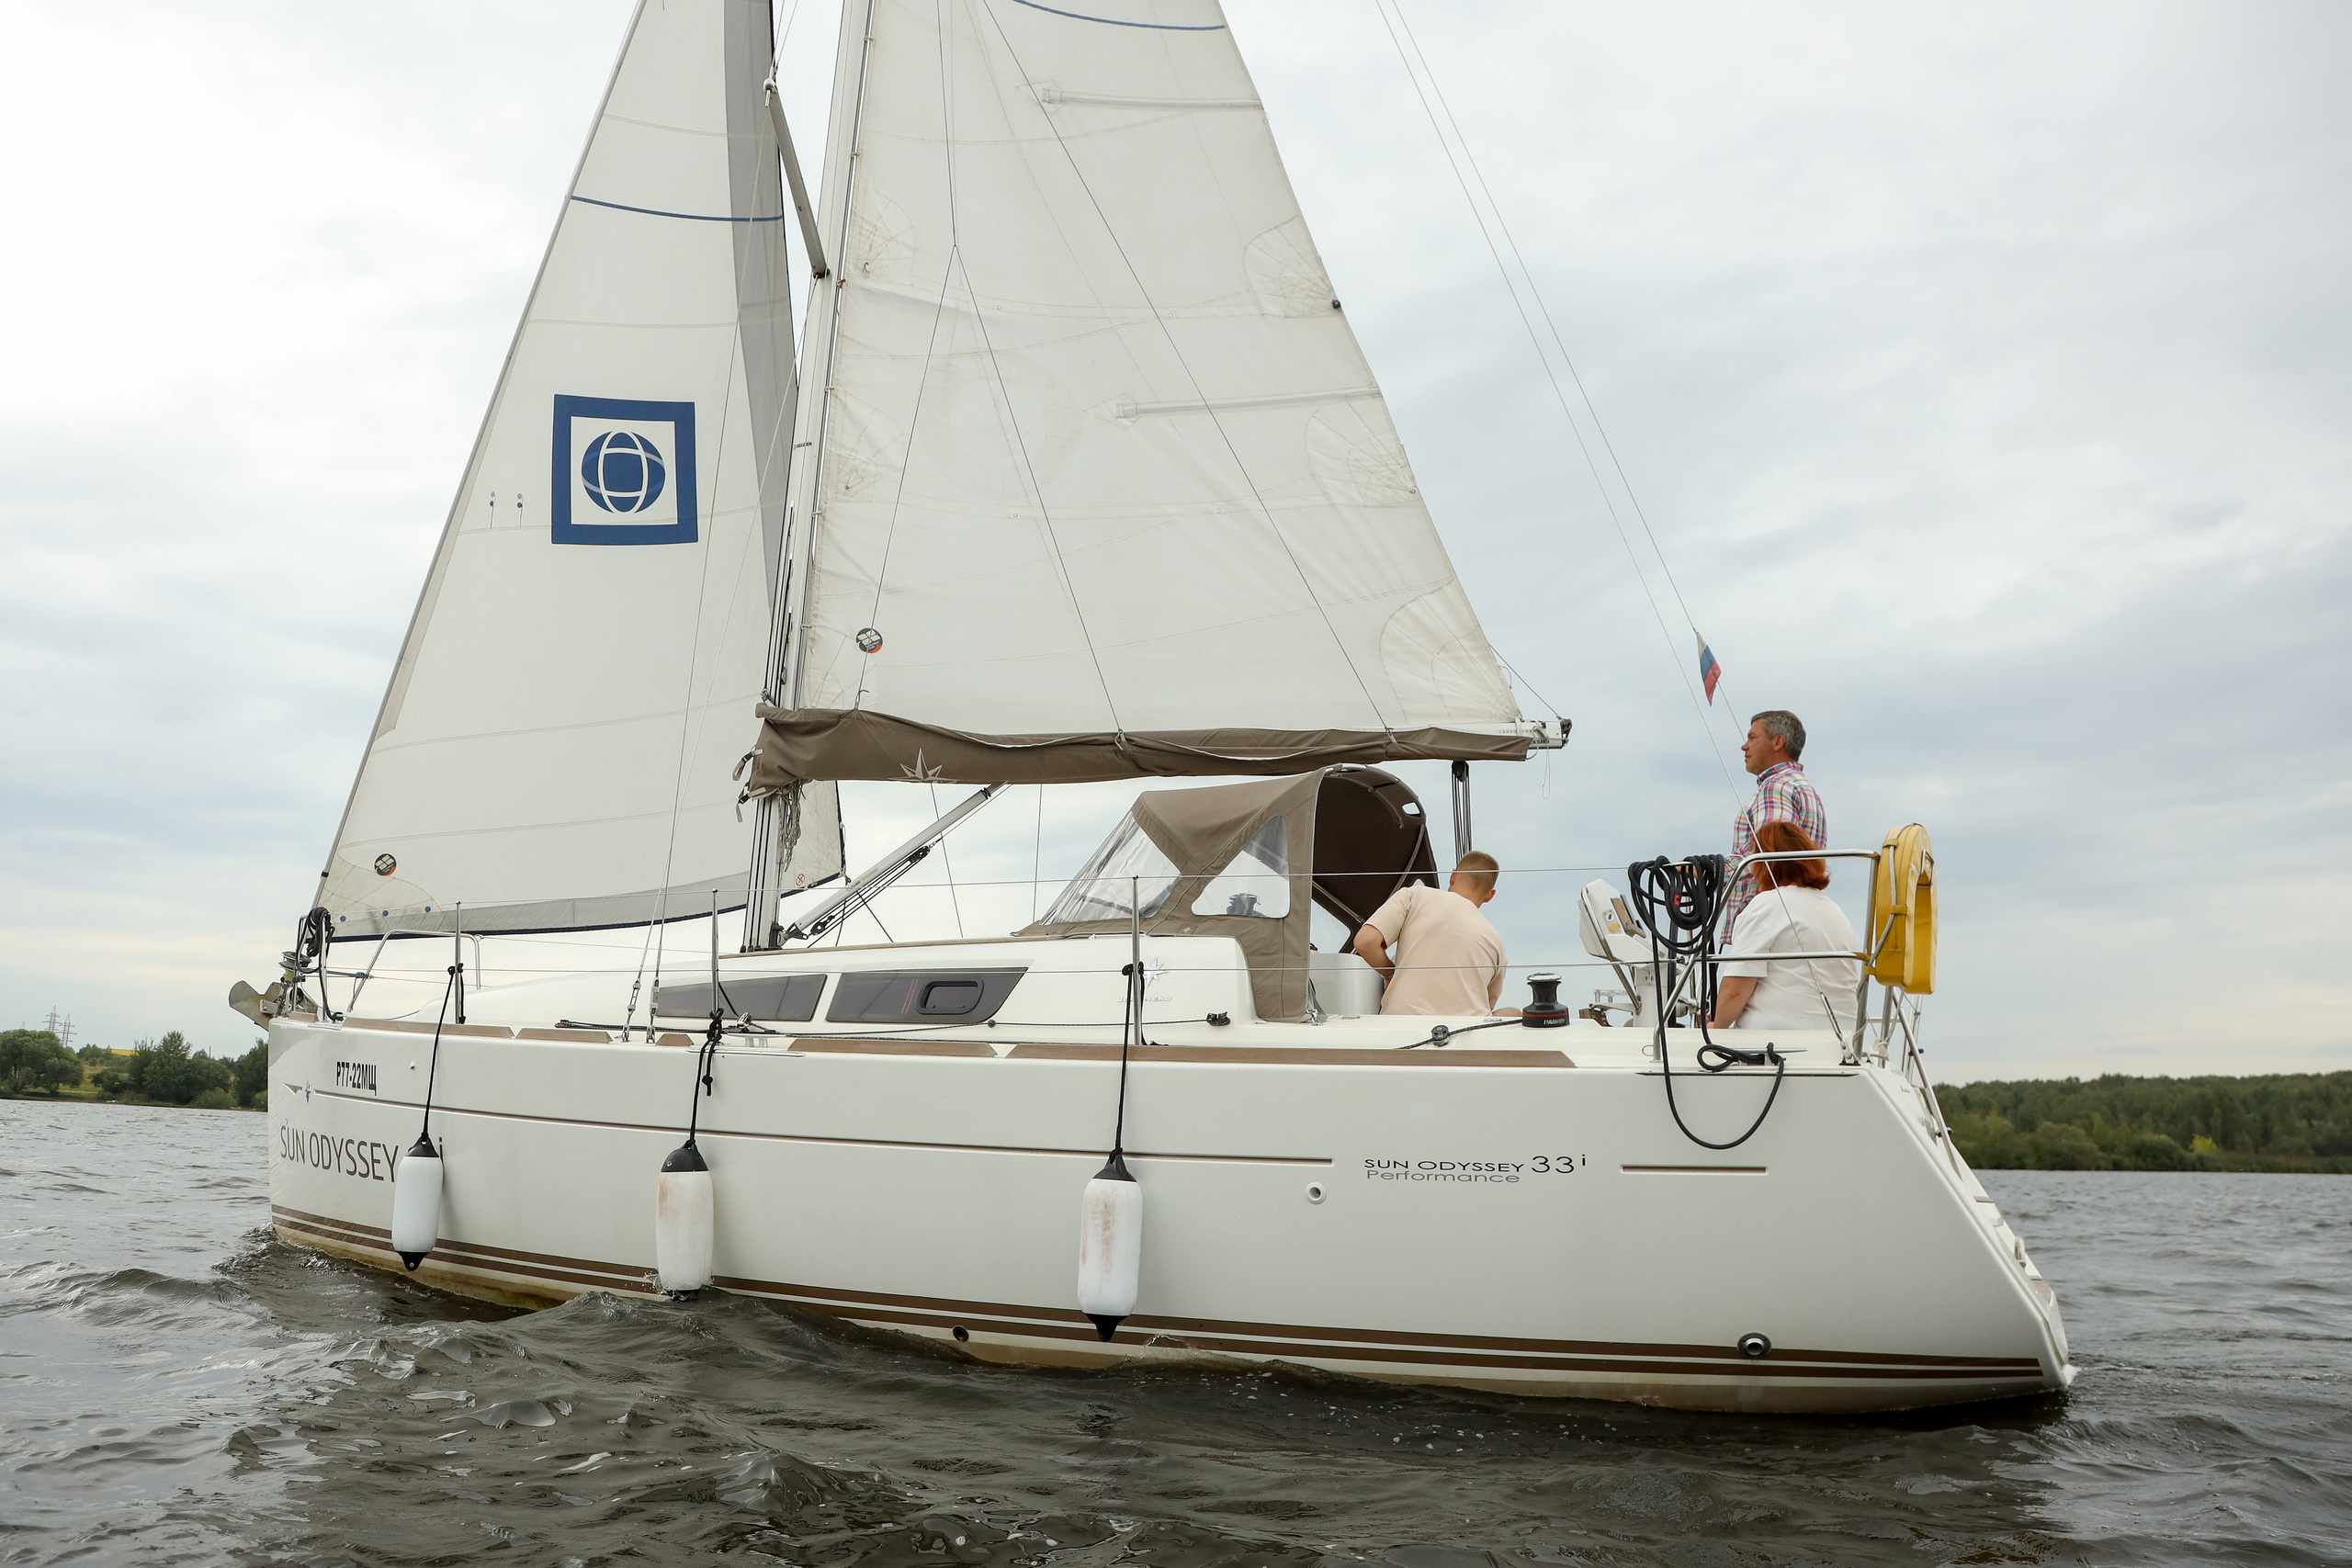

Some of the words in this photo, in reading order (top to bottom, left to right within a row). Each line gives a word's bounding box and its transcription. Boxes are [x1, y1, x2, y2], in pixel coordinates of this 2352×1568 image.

[280, 1125, 307, 1165] SUN
[309, 1132, 400, 1183] ODYSSEY
[1363, 1158, 1409, 1169] SUN
[1418, 1160, 1525, 1173] ODYSSEY
[1366, 1169, 1521, 1183] Performance
